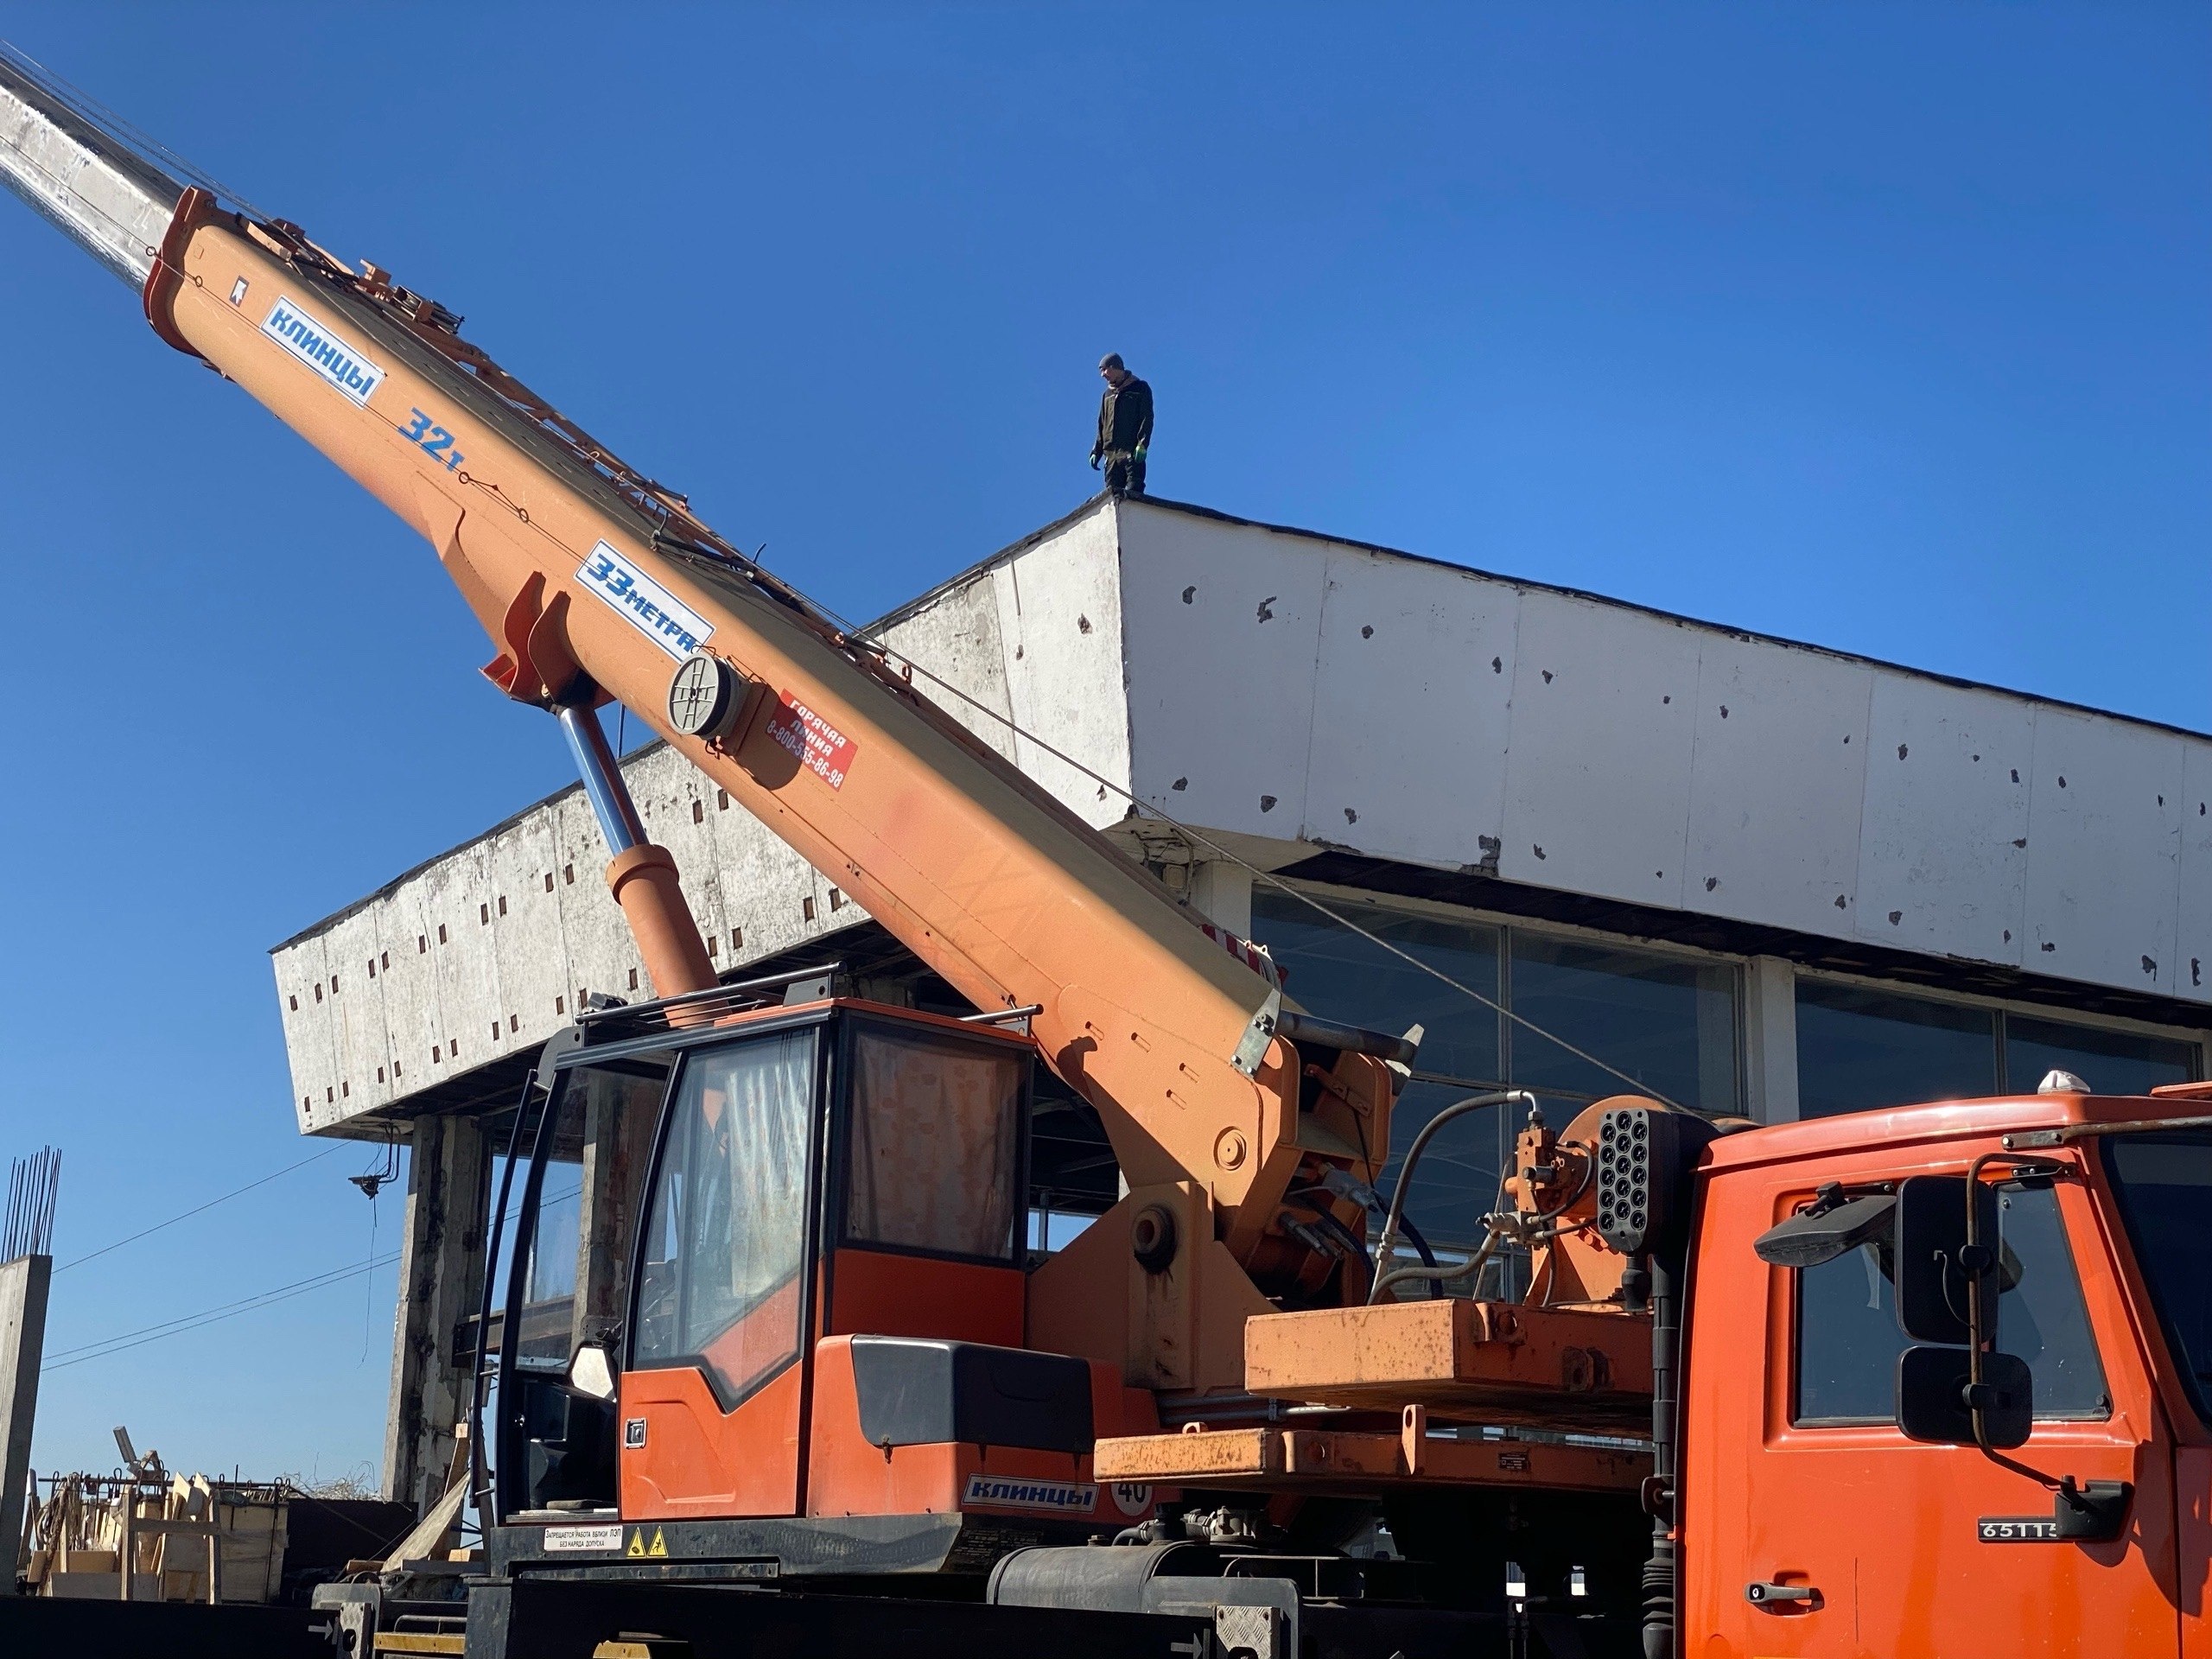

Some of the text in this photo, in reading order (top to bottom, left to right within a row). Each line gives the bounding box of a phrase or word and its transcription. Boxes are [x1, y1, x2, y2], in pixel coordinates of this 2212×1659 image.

[270, 307, 375, 397] КЛИНЦЫ
[789, 699, 847, 748] ГОРЯЧАЯ
[790, 719, 834, 757] ЛИНИЯ
[766, 719, 844, 788] 8-800-555-86-98
[971, 1481, 1093, 1506] КЛИНЦЫ
[1117, 1483, 1147, 1503] 40
[609, 1529, 621, 1537] ЛЭП
